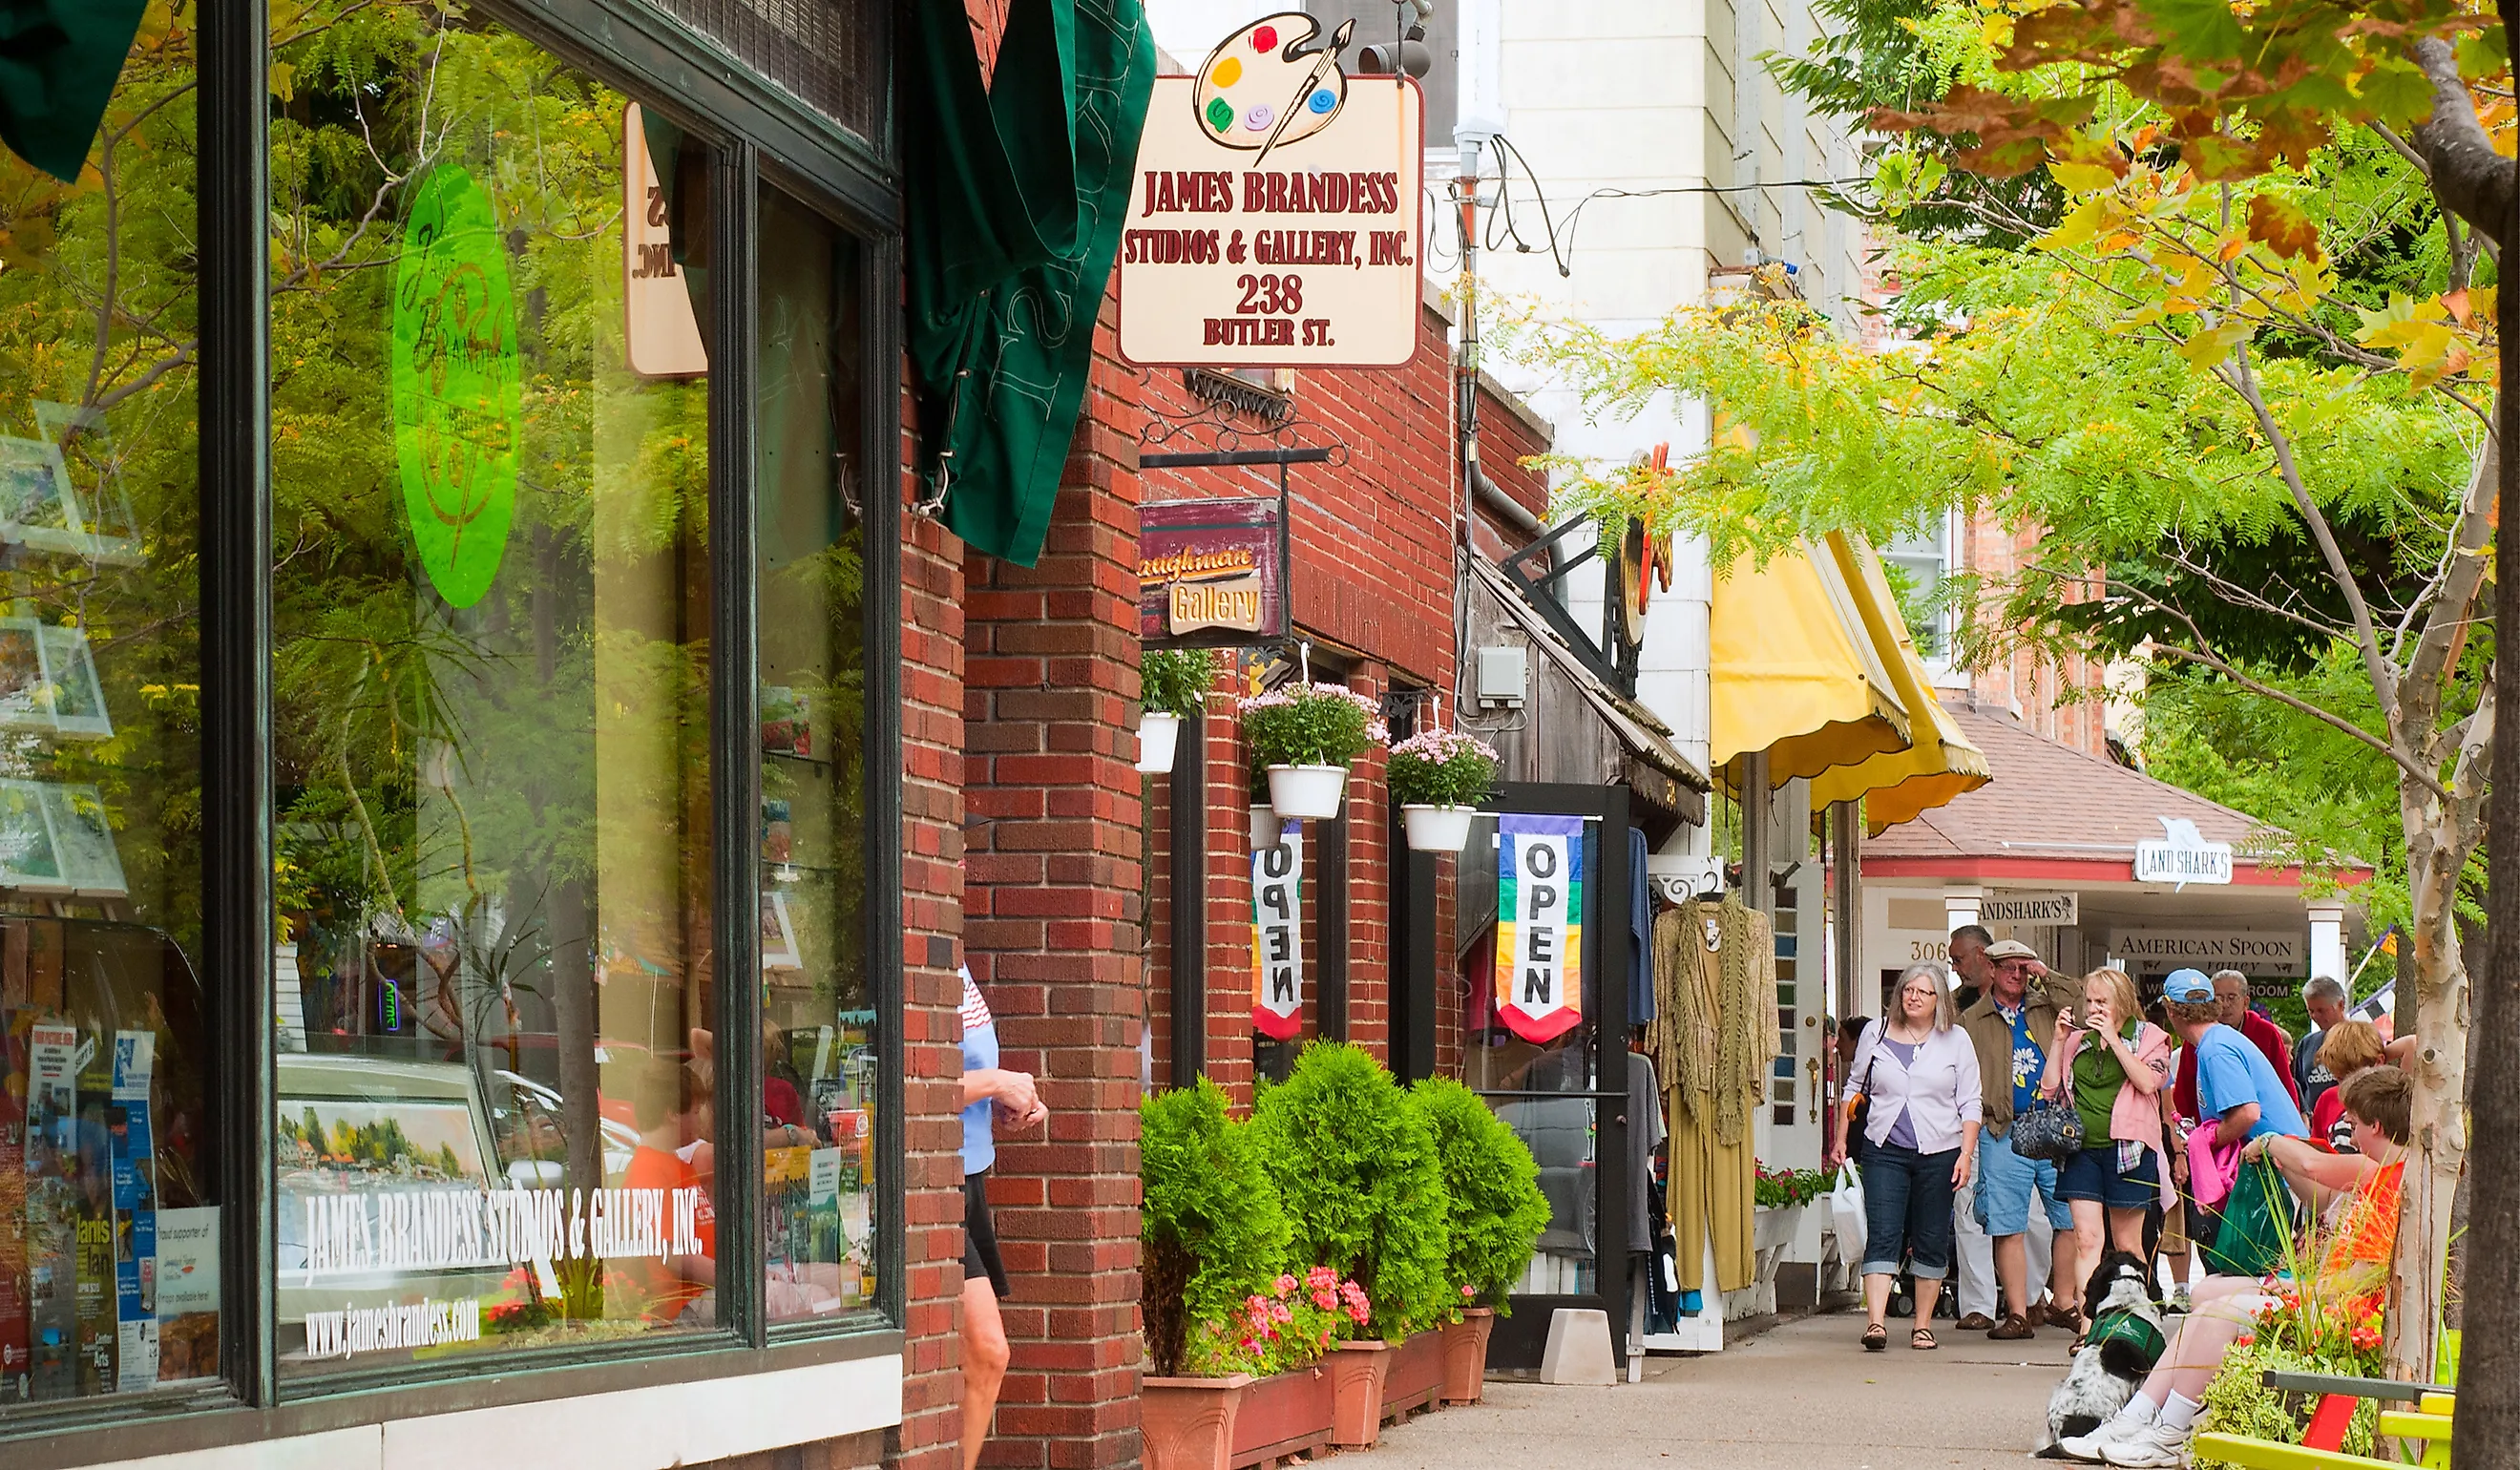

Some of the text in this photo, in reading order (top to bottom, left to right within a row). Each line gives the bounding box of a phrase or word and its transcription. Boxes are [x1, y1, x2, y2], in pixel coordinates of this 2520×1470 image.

[1142, 172, 1397, 218] JAMES BRANDESS
[1124, 229, 1413, 270] STUDIOS & GALLERY, INC.
[1236, 274, 1303, 314] 238
[1203, 319, 1335, 346] BUTLER ST.
[1173, 586, 1258, 626] Gallery
[2141, 849, 2228, 878] LAND SHARK'S
[1523, 843, 1557, 1004] OPEN
[1977, 899, 2062, 921] ANDSHARK'S
[1911, 941, 1946, 961] 306
[2120, 935, 2292, 956] AMERICAN SPOON
[2247, 985, 2289, 998] ROOM
[174, 1228, 200, 1243] supporter
[304, 1193, 371, 1287] JAMES
[379, 1189, 482, 1270] BRANDESS
[487, 1187, 565, 1261] STUDIOS
[569, 1188, 585, 1259] &
[590, 1187, 668, 1266] GALLERY,
[672, 1186, 704, 1256] INC.
[305, 1296, 480, 1360] www.jamesbrandess.com
